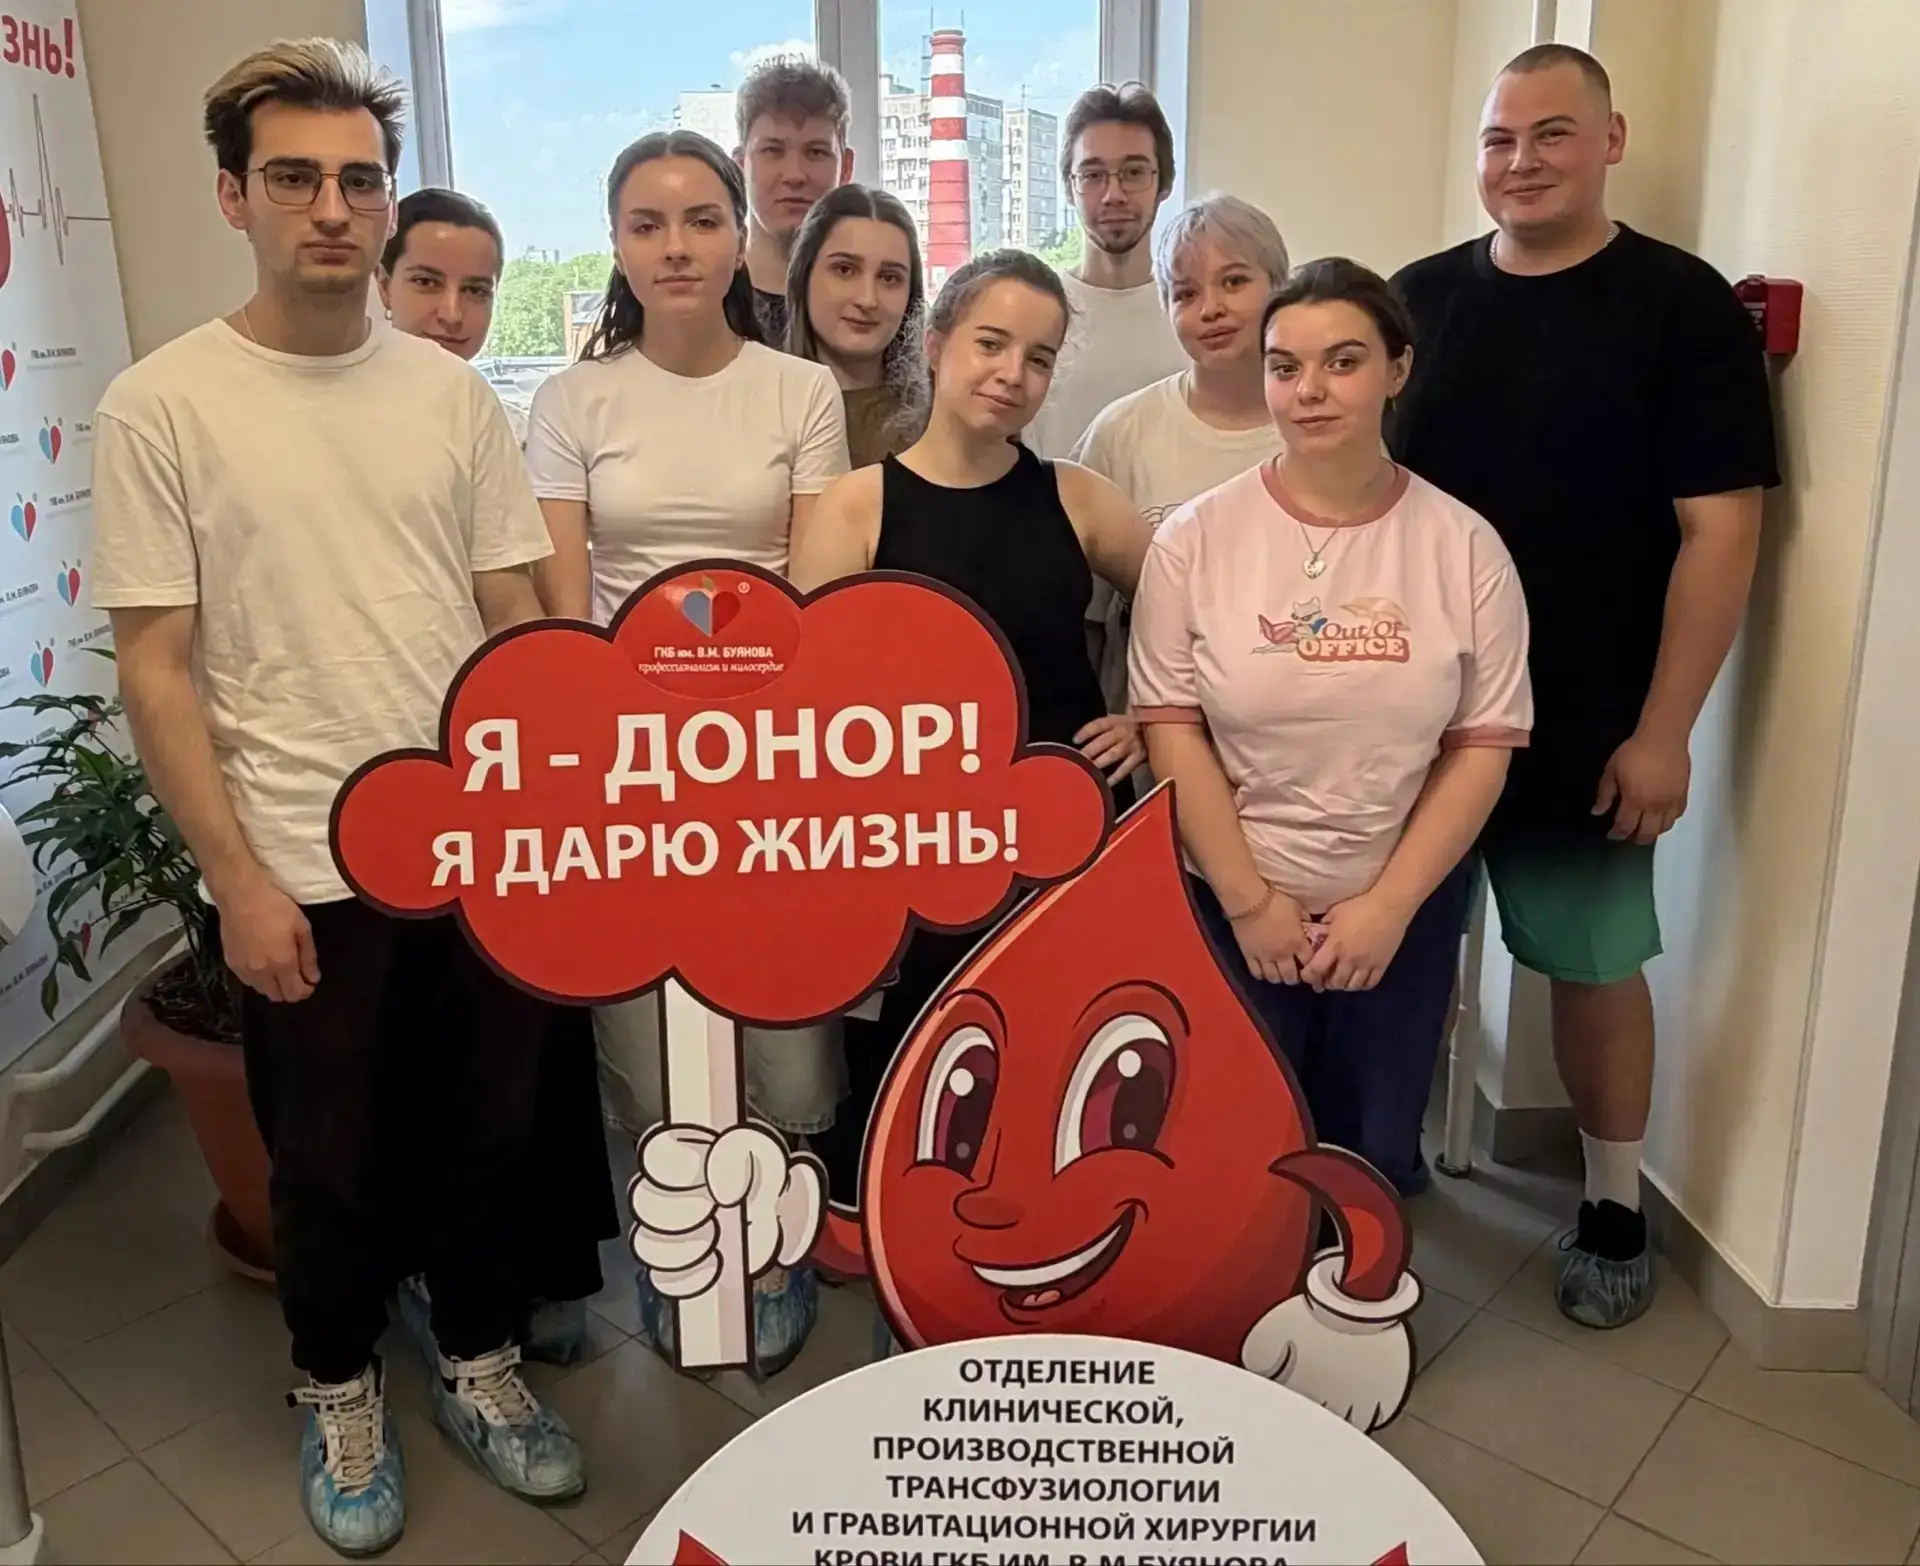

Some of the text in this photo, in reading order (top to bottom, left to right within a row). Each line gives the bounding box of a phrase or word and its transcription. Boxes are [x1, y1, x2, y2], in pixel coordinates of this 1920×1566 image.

[1, 14, 76, 79] ЗНЬ!
[1322, 623, 1369, 639] Out
[654, 646, 675, 658] ГКБ
[697, 646, 720, 658] В.М.
[723, 646, 773, 658] БУЯНОВА
[1299, 638, 1407, 660] OFFICE
[638, 661, 784, 674] профессионализм и милосердие
[462, 702, 983, 804] Я - ДОНОР!
[430, 809, 1019, 897] Я ДАРЮ ЖИЗНЬ!
[959, 1359, 1156, 1389] ОТДЕЛЕНИЕ
[923, 1396, 1184, 1428] КЛИНИЧЕСКОЙ,
[872, 1436, 1235, 1468] ПРОИЗВОДСТВЕННОЙ
[886, 1475, 1221, 1503] ТРАНСФУЗИОЛОГИИ
[792, 1511, 1316, 1543] И ГРАВИТАЦИОННОЙ ХИРУРГИИ
[815, 1549, 923, 1565] КРОВИ
